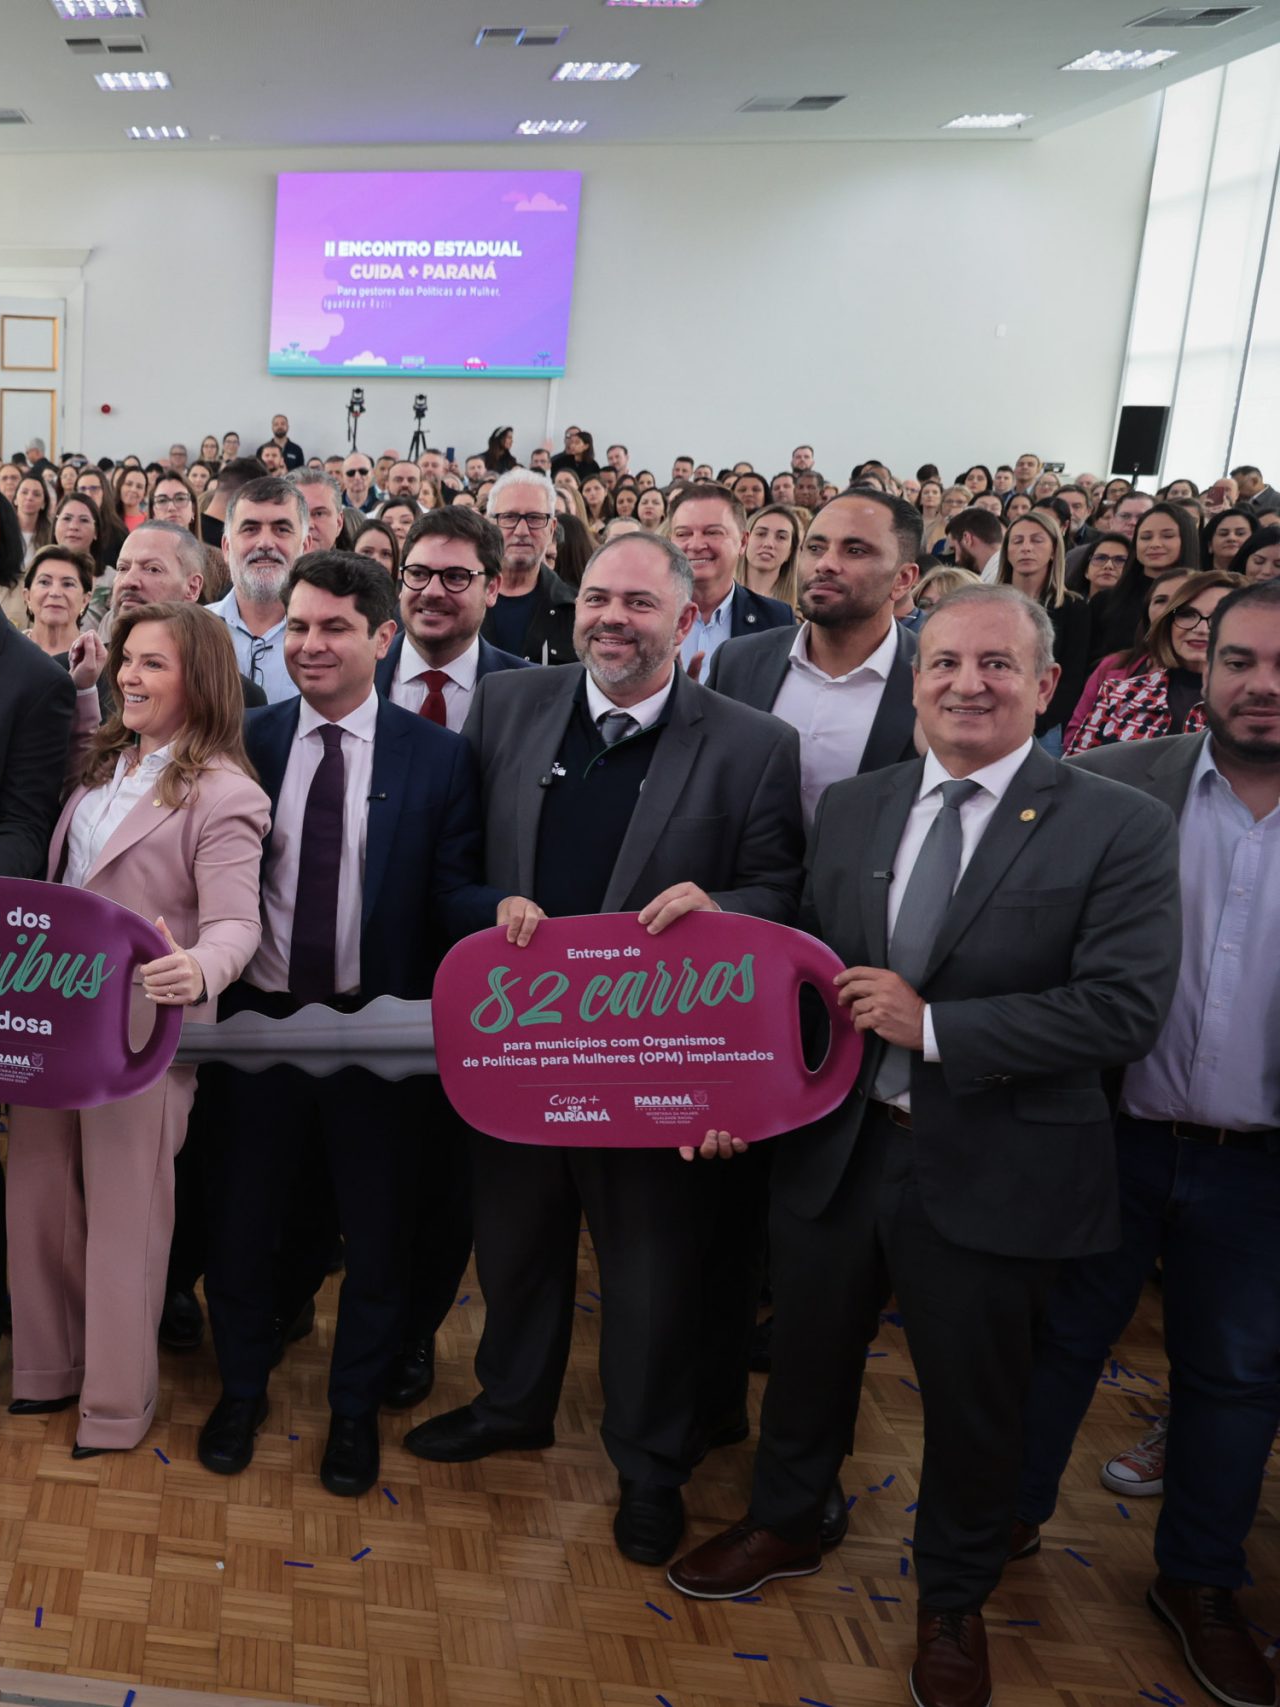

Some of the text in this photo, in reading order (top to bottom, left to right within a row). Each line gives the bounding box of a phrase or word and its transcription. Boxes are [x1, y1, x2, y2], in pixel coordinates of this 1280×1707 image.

[324, 241, 522, 257] II ENCONTRO ESTADUAL
[350, 260, 497, 279] CUIDA + PARANÁ
[337, 286, 357, 297] Para
[359, 286, 396, 298] gestores
[399, 286, 415, 297] das
[455, 287, 467, 297] da
[7, 906, 52, 930] dos
[567, 945, 641, 959] Entrega de
[470, 954, 754, 1033] 82 carros
[503, 1035, 726, 1052] para municípios com Organismos
[462, 1050, 774, 1067] de Políticas para Mulheres (OPM) implantados
[634, 1093, 693, 1106] PARANÁ
[544, 1109, 611, 1122] PARANÁ
